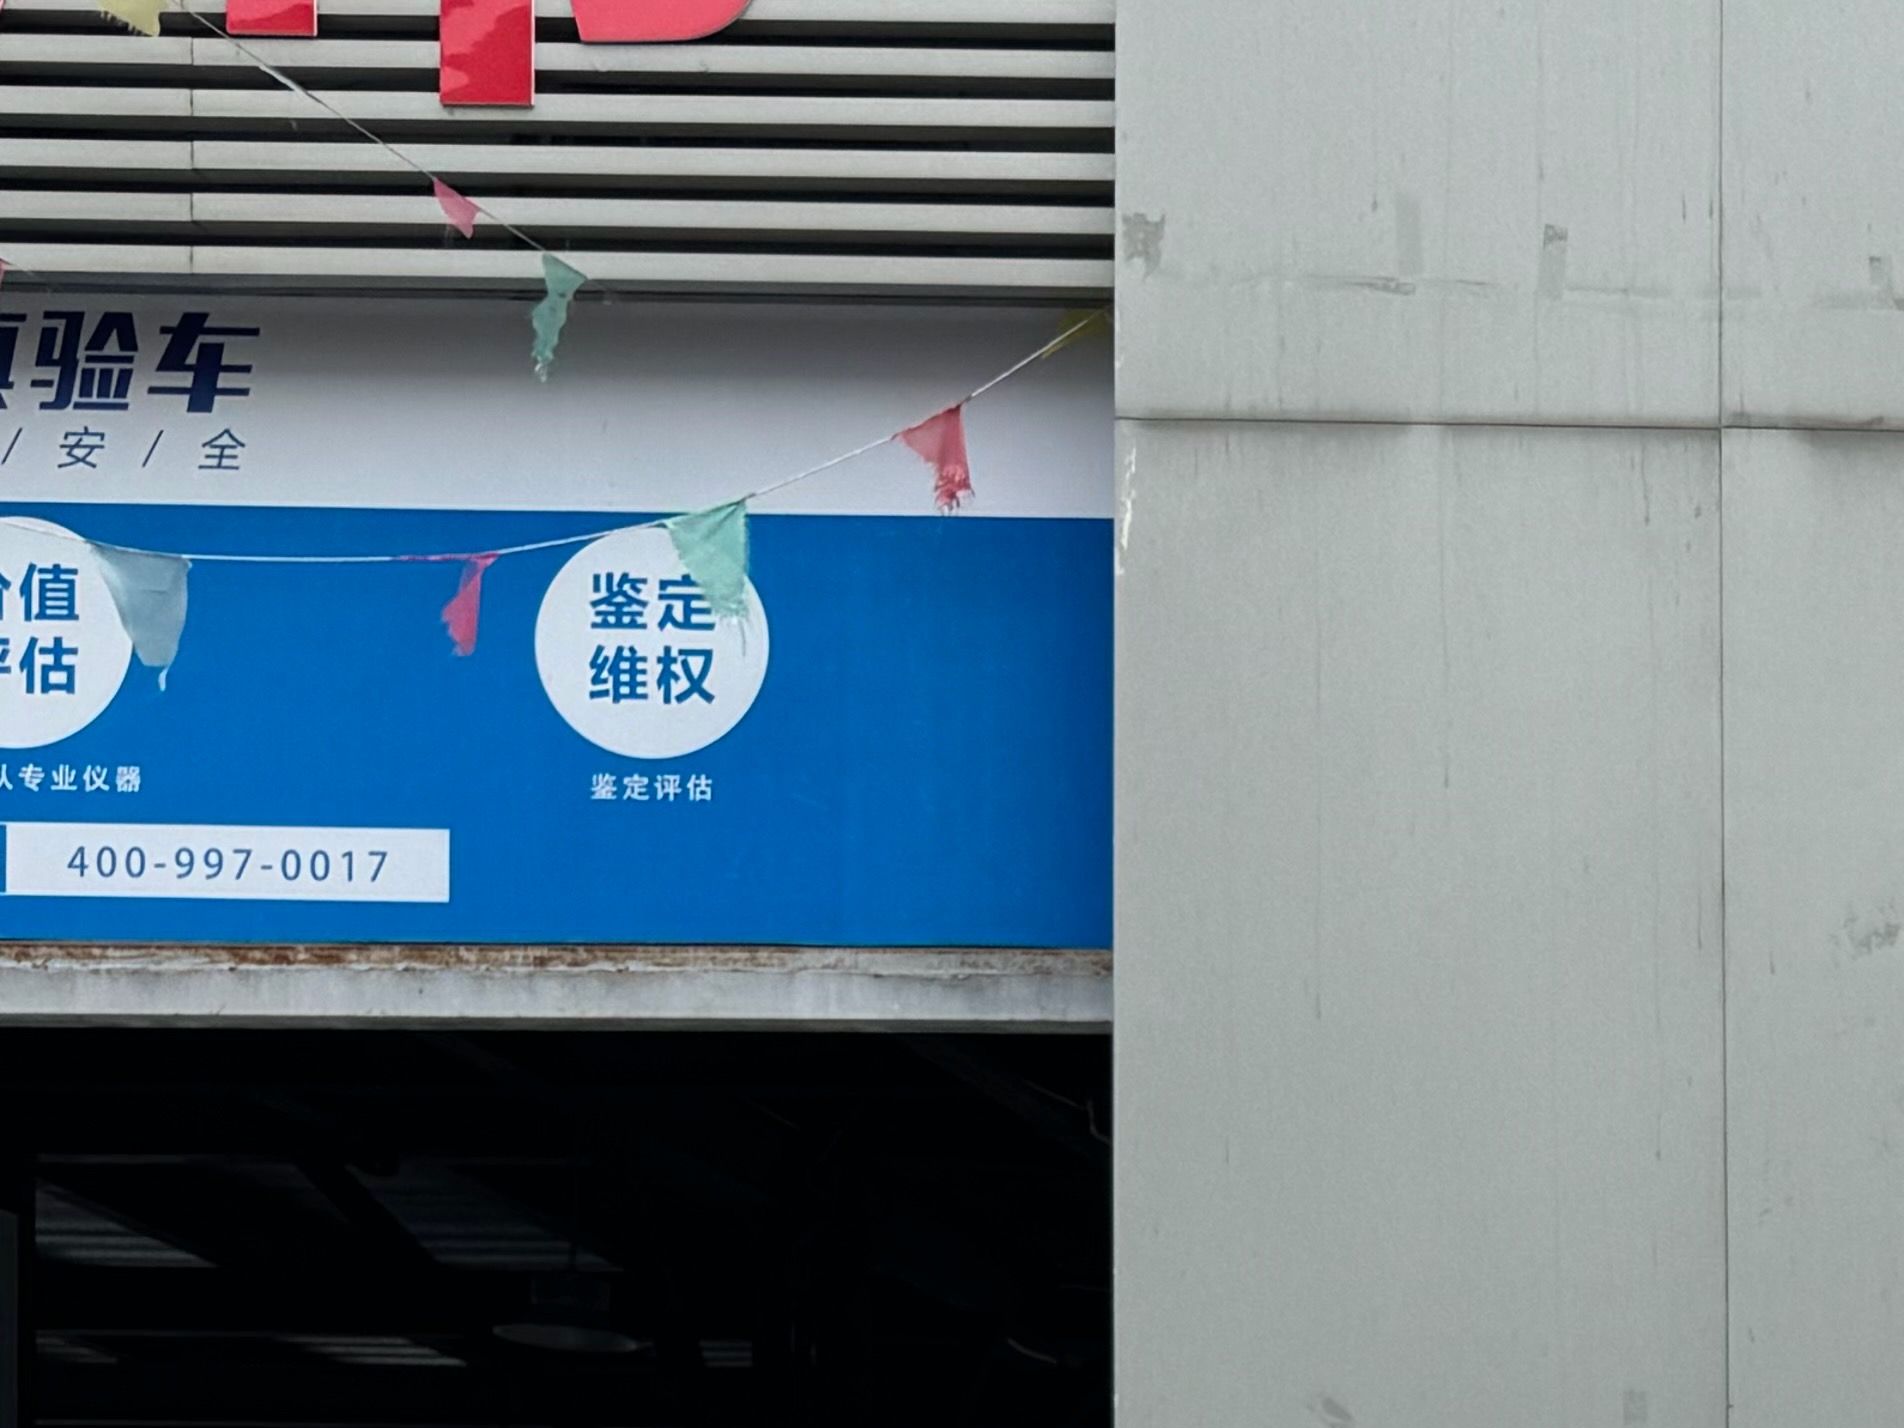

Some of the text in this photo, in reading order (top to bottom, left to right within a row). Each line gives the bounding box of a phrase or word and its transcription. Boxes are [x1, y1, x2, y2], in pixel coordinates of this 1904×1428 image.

[0, 563, 79, 622] 值
[590, 572, 716, 632] 鉴定
[0, 636, 79, 695] 估
[589, 645, 716, 705] 维权
[591, 773, 712, 801] 鉴定评估
[67, 846, 387, 882] 400-997-0017
